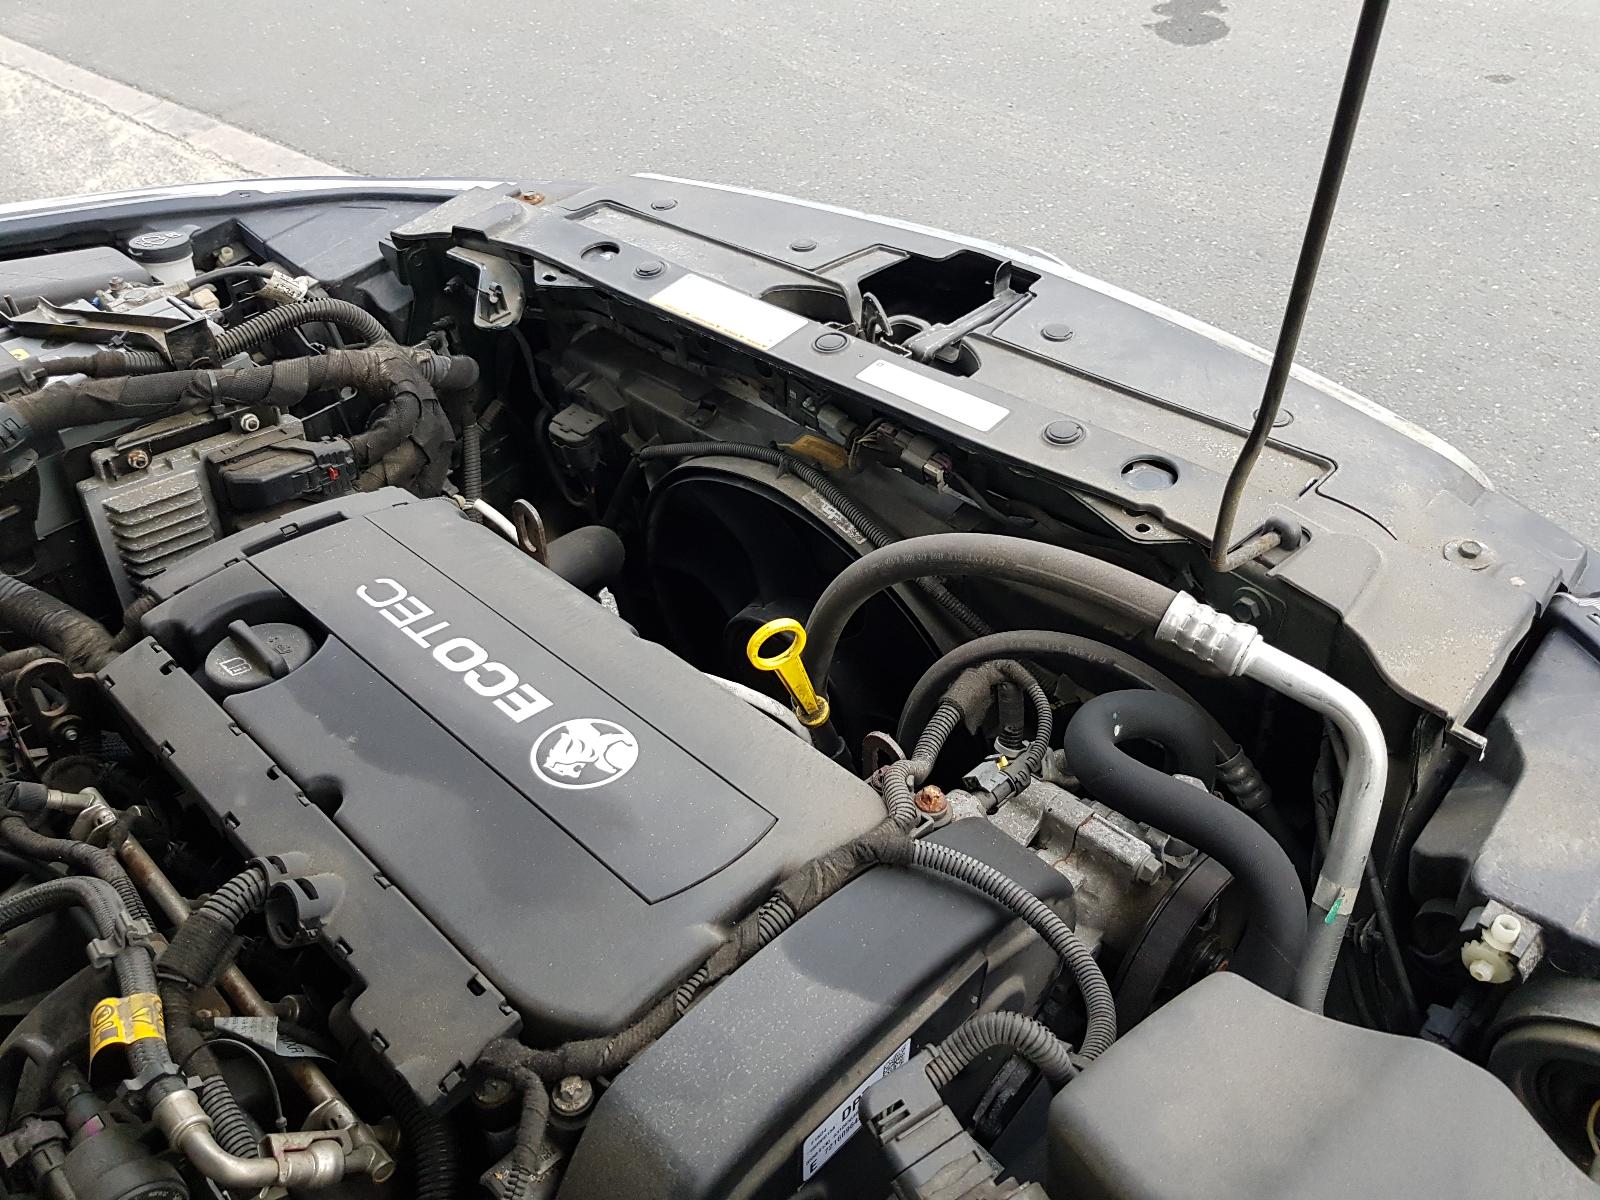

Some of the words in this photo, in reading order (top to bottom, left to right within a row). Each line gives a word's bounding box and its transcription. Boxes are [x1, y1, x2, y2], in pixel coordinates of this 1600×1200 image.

[356, 578, 554, 723] ECOTEC
[842, 1088, 868, 1122] DP
[809, 1159, 818, 1174] E
